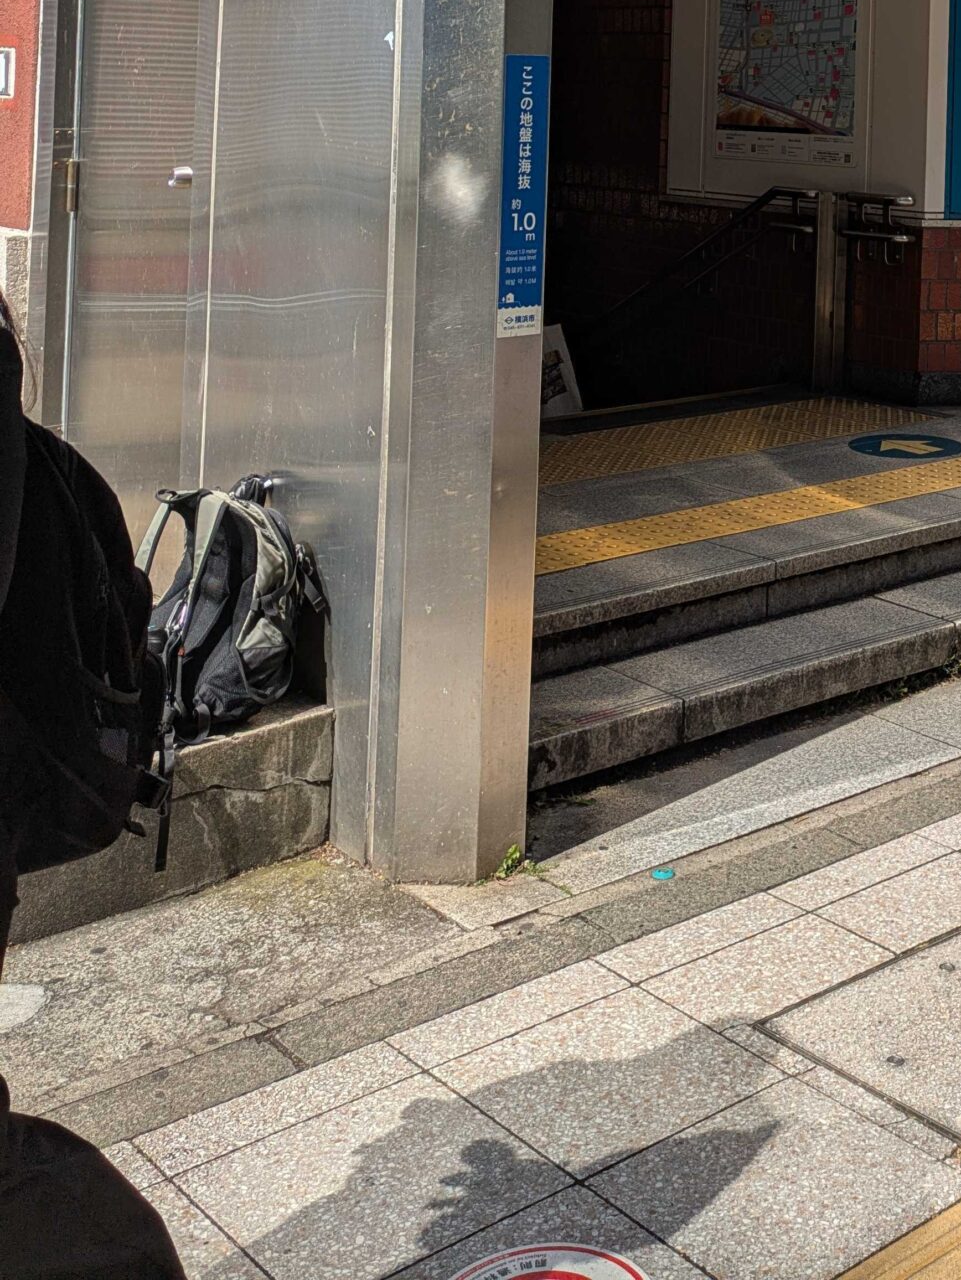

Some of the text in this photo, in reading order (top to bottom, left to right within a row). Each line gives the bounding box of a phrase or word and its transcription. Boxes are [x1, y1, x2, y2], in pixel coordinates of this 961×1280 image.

[518, 66, 533, 190] ここの地盤は海抜
[511, 199, 522, 210] 約
[511, 212, 536, 232] 1.0
[525, 232, 536, 241] m
